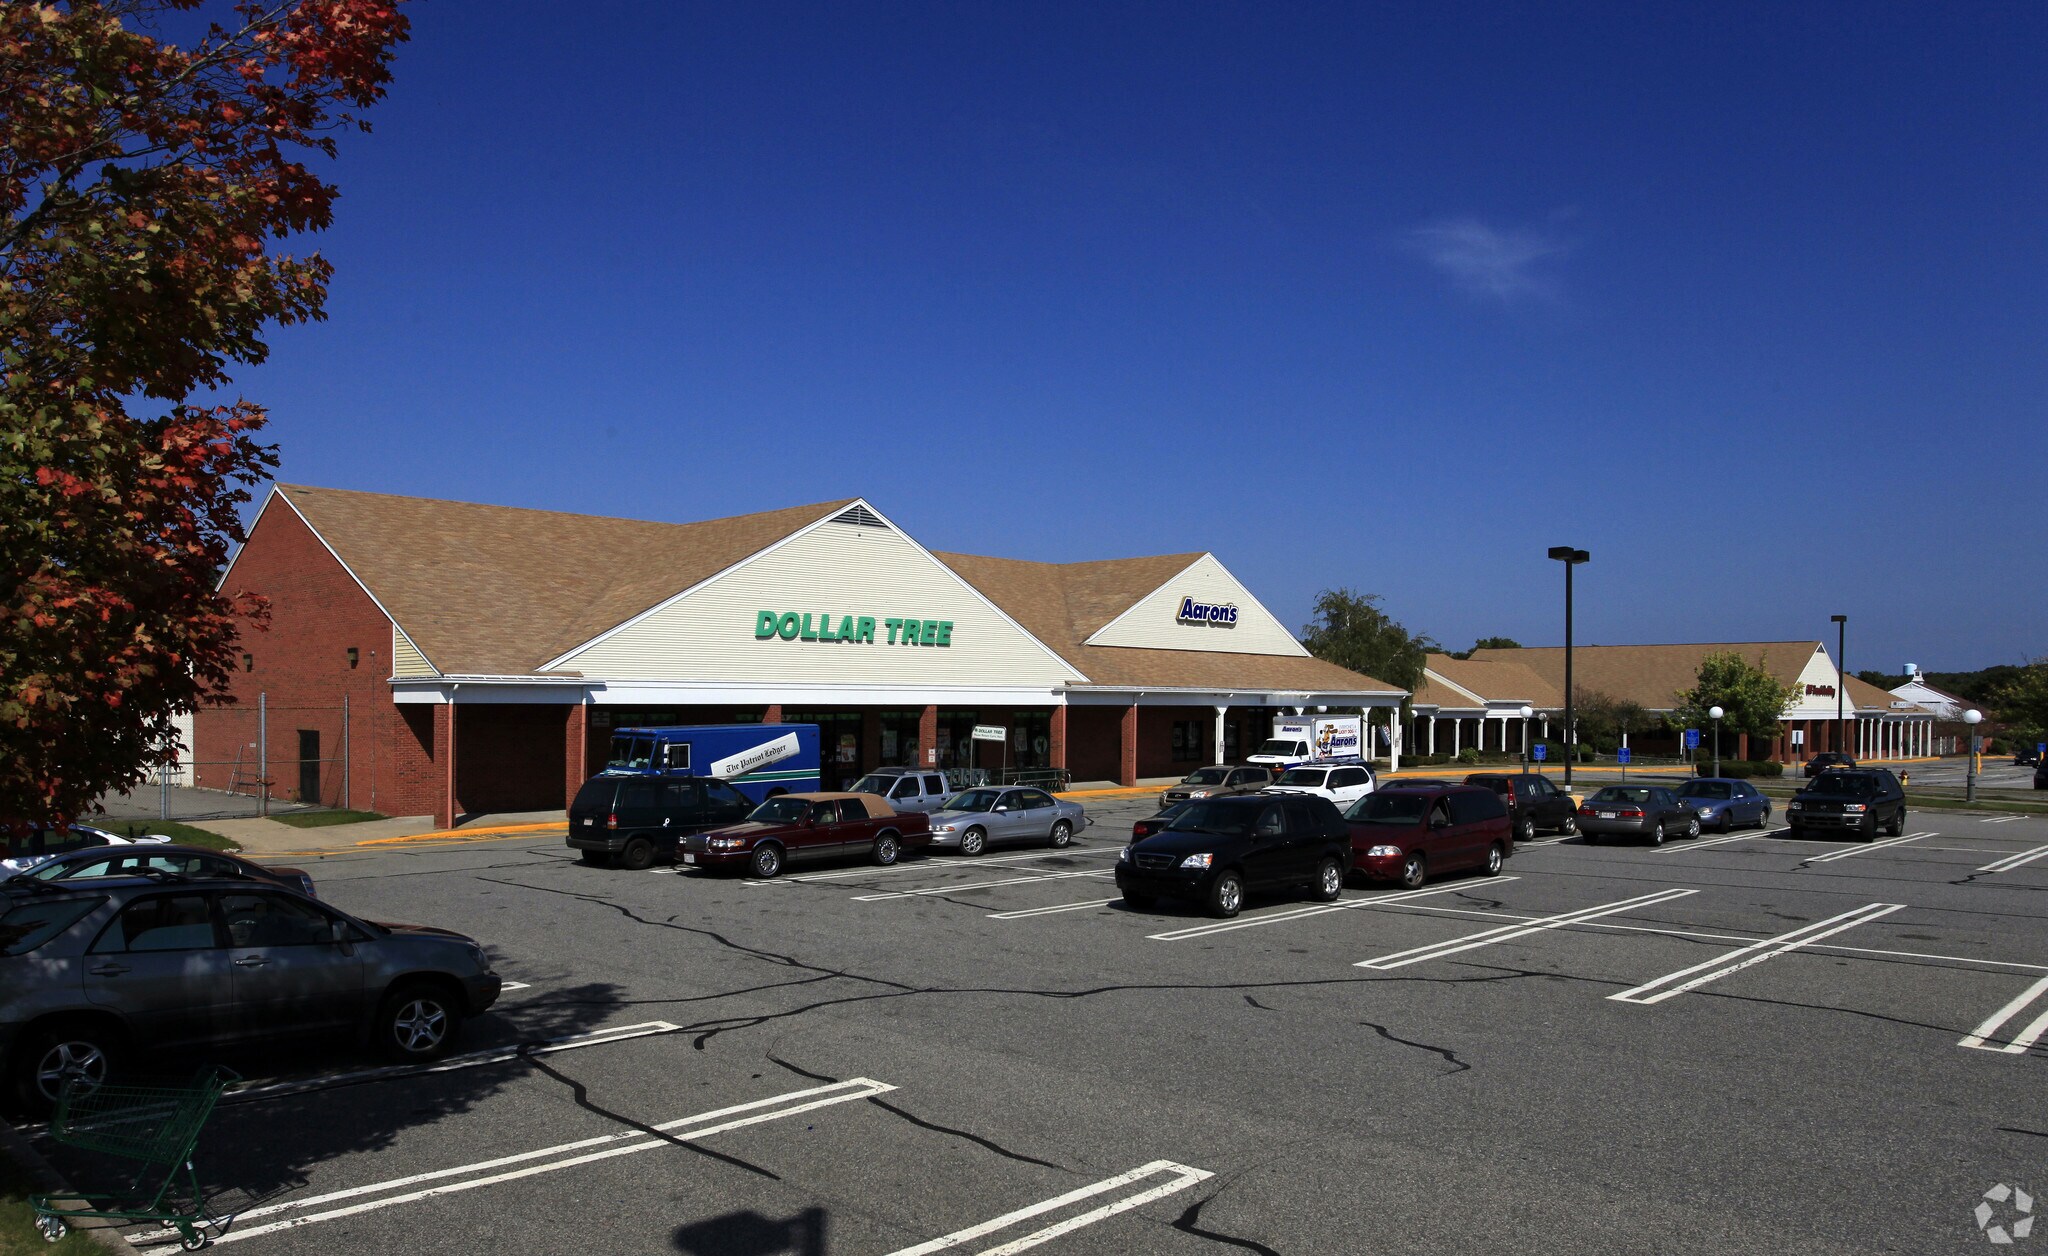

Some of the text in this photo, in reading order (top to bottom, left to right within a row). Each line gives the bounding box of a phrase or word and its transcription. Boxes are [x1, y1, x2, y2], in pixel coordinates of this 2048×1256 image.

[1179, 598, 1238, 622] Aaron's
[755, 610, 954, 646] DOLLAR TREE
[1330, 734, 1357, 747] Aaron's
[725, 744, 787, 774] The Patriot Ledger
